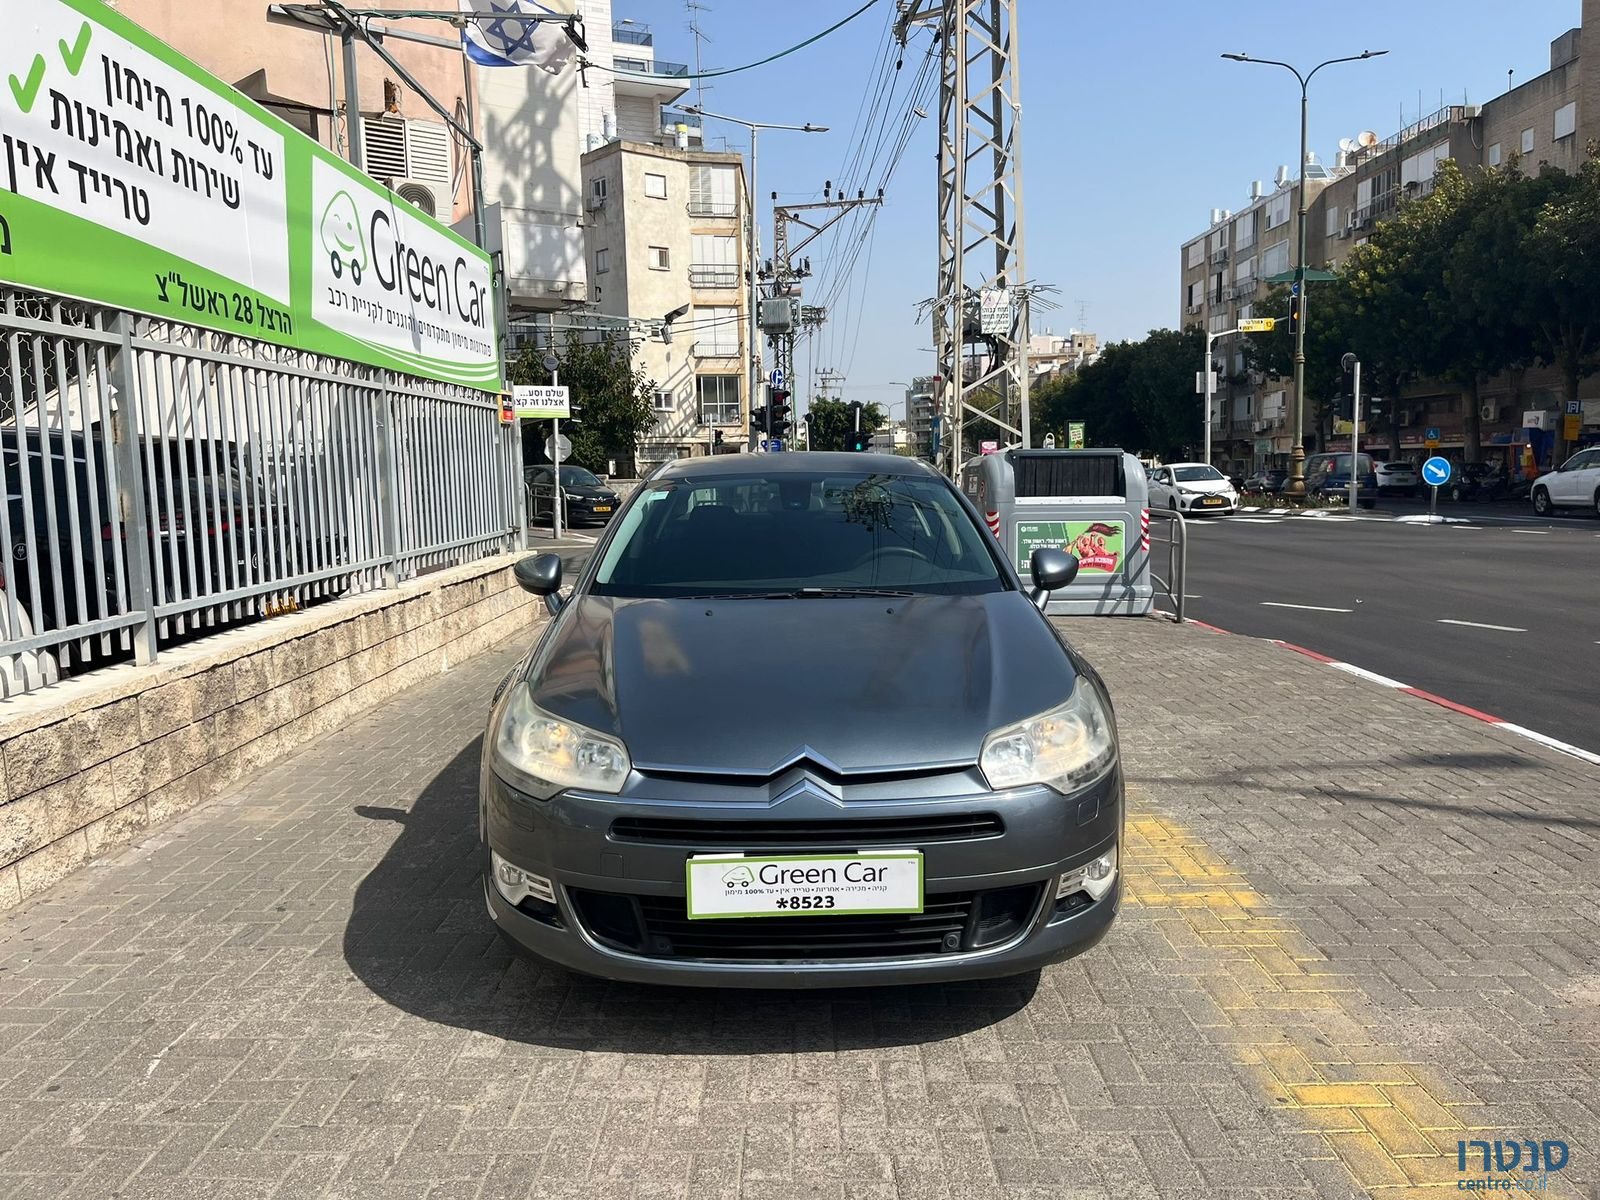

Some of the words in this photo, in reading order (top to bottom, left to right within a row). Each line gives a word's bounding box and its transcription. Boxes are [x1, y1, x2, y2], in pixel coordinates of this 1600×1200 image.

[101, 54, 173, 126] מימון
[49, 88, 163, 175] ואמינות
[181, 97, 243, 164] 100%
[3, 134, 59, 194] אין
[248, 139, 273, 181] עד
[68, 160, 150, 225] טרייד
[171, 148, 240, 209] שירות
[371, 209, 450, 315] Green
[454, 257, 486, 329] Car
[233, 293, 254, 324] 28
[328, 287, 348, 309] רכב
[352, 296, 383, 323] לקניית
[257, 299, 292, 335] הרצל
[419, 320, 450, 344] מתקדמים
[452, 331, 469, 349] מימון
[542, 398, 564, 406] אצלנו
[545, 389, 564, 398] שלם
[759, 864, 836, 885] Green
[844, 862, 888, 883] Car
